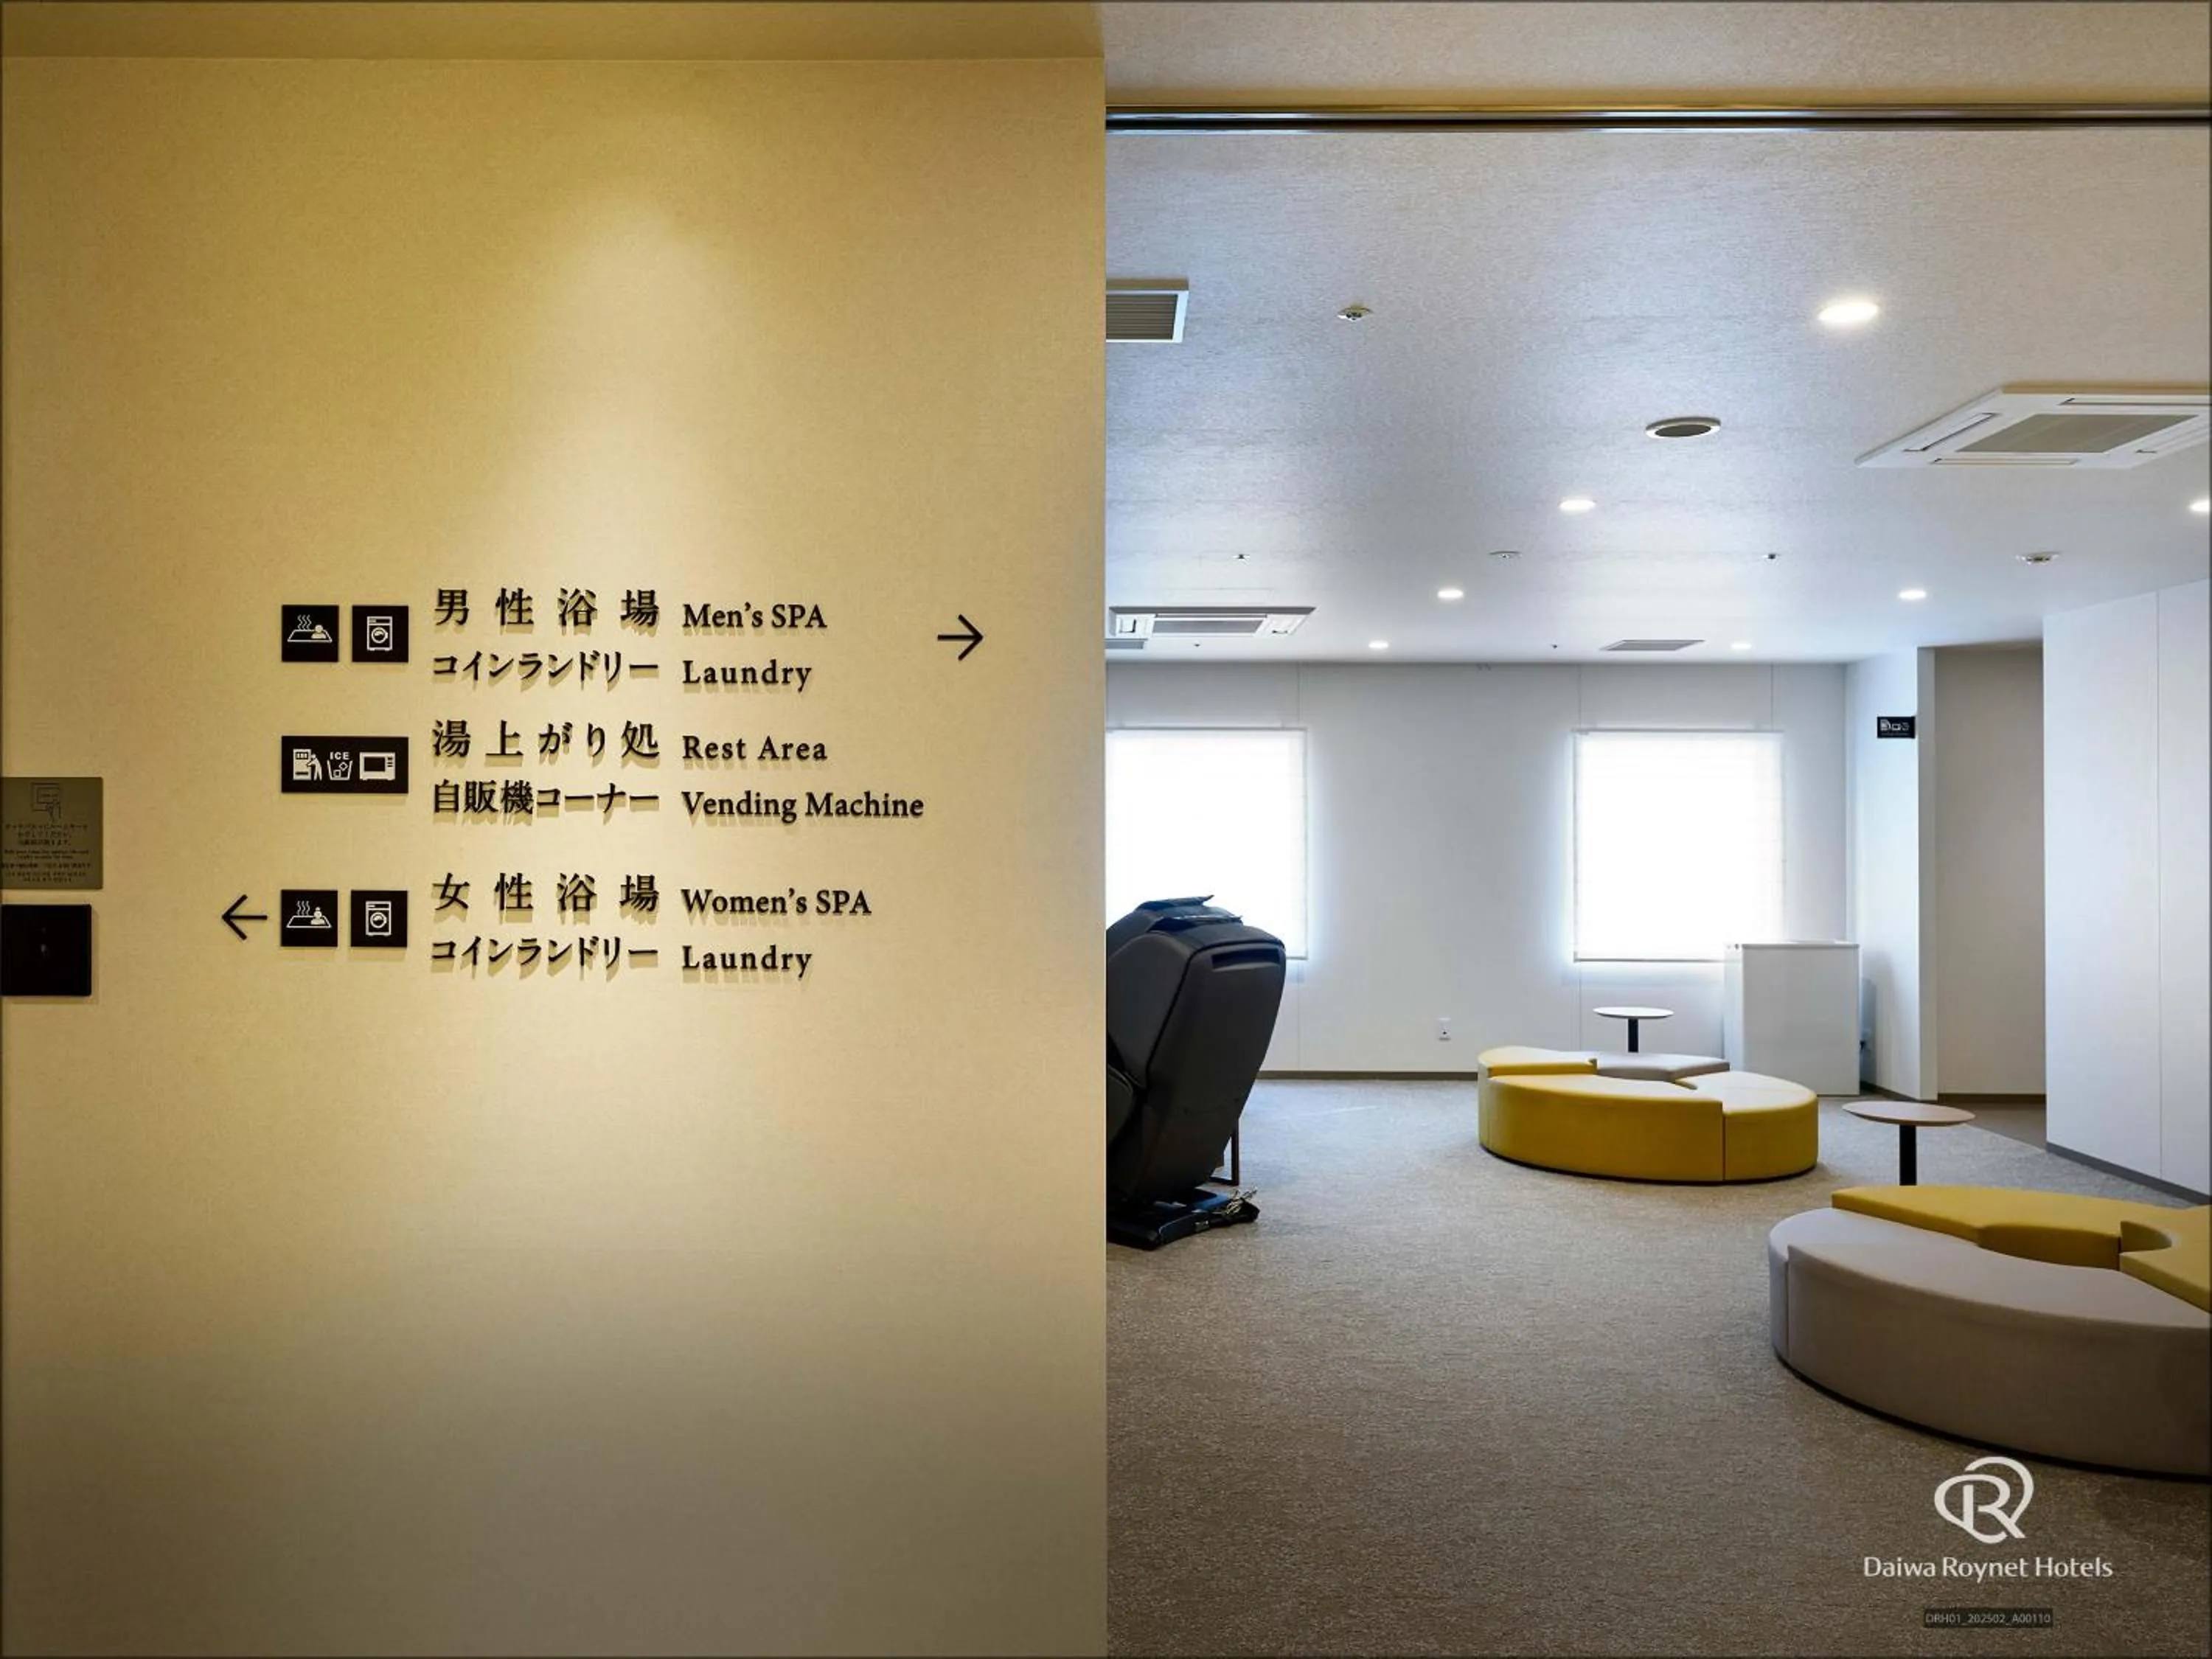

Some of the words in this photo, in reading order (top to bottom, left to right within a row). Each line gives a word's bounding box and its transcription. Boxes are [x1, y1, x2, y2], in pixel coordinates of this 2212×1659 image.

[434, 588, 659, 627] 男性浴場
[683, 602, 763, 628] Men’s
[771, 604, 827, 628] SPA
[433, 650, 658, 683] コインランドリー
[682, 659, 812, 692] Laundry
[330, 751, 350, 759] ICE
[432, 719, 660, 759] 湯上がり処
[682, 735, 746, 761] Rest
[757, 735, 827, 761] Area
[433, 779, 659, 815] 自販機コーナー
[681, 790, 797, 824] Vending
[805, 791, 924, 817] Machine
[431, 872, 659, 912] 女性浴場
[681, 888, 807, 916] Women’s
[816, 889, 872, 916] SPA
[431, 936, 658, 970] コインランドリー
[682, 945, 813, 980] Laundry
